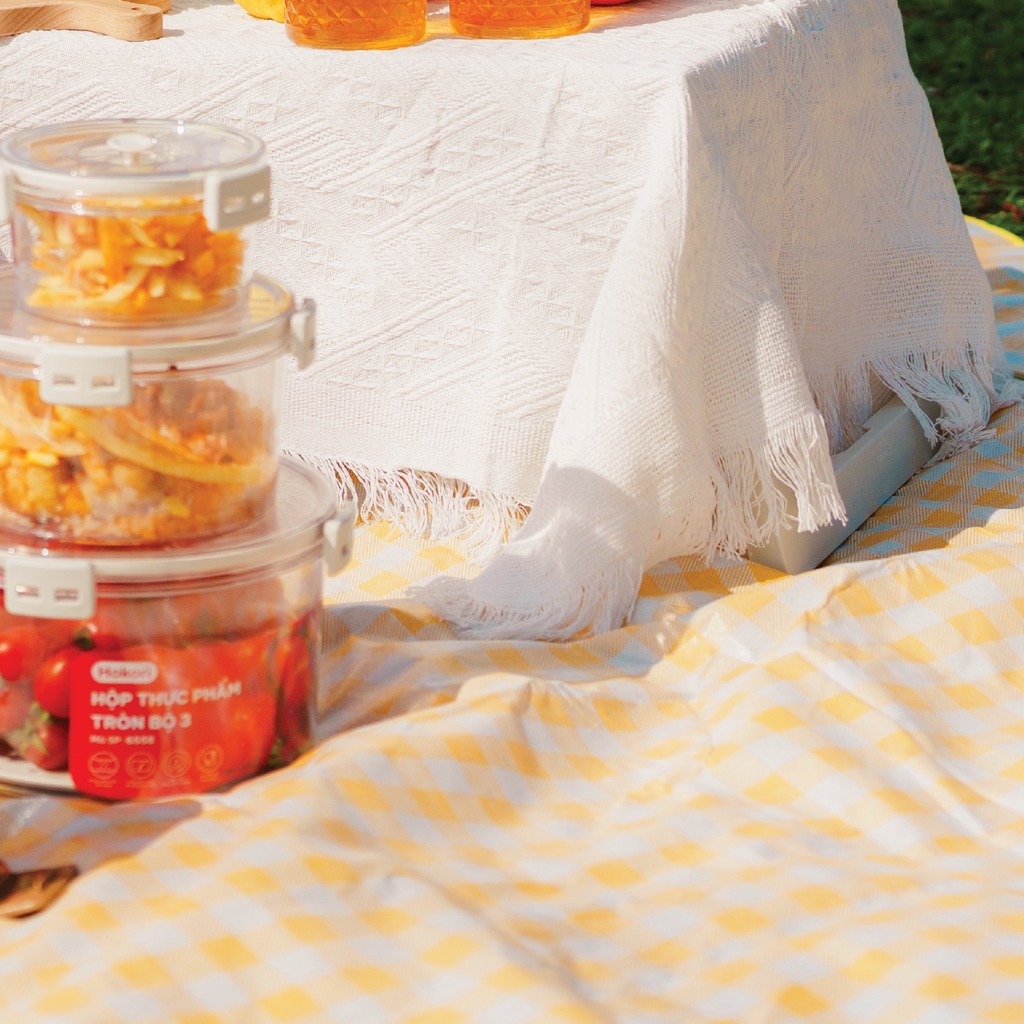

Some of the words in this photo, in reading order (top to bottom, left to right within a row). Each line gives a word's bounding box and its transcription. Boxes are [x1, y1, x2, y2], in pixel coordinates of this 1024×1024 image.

[90, 687, 133, 711] HỘP
[147, 712, 176, 733] BỘ
[179, 712, 192, 728] 3
